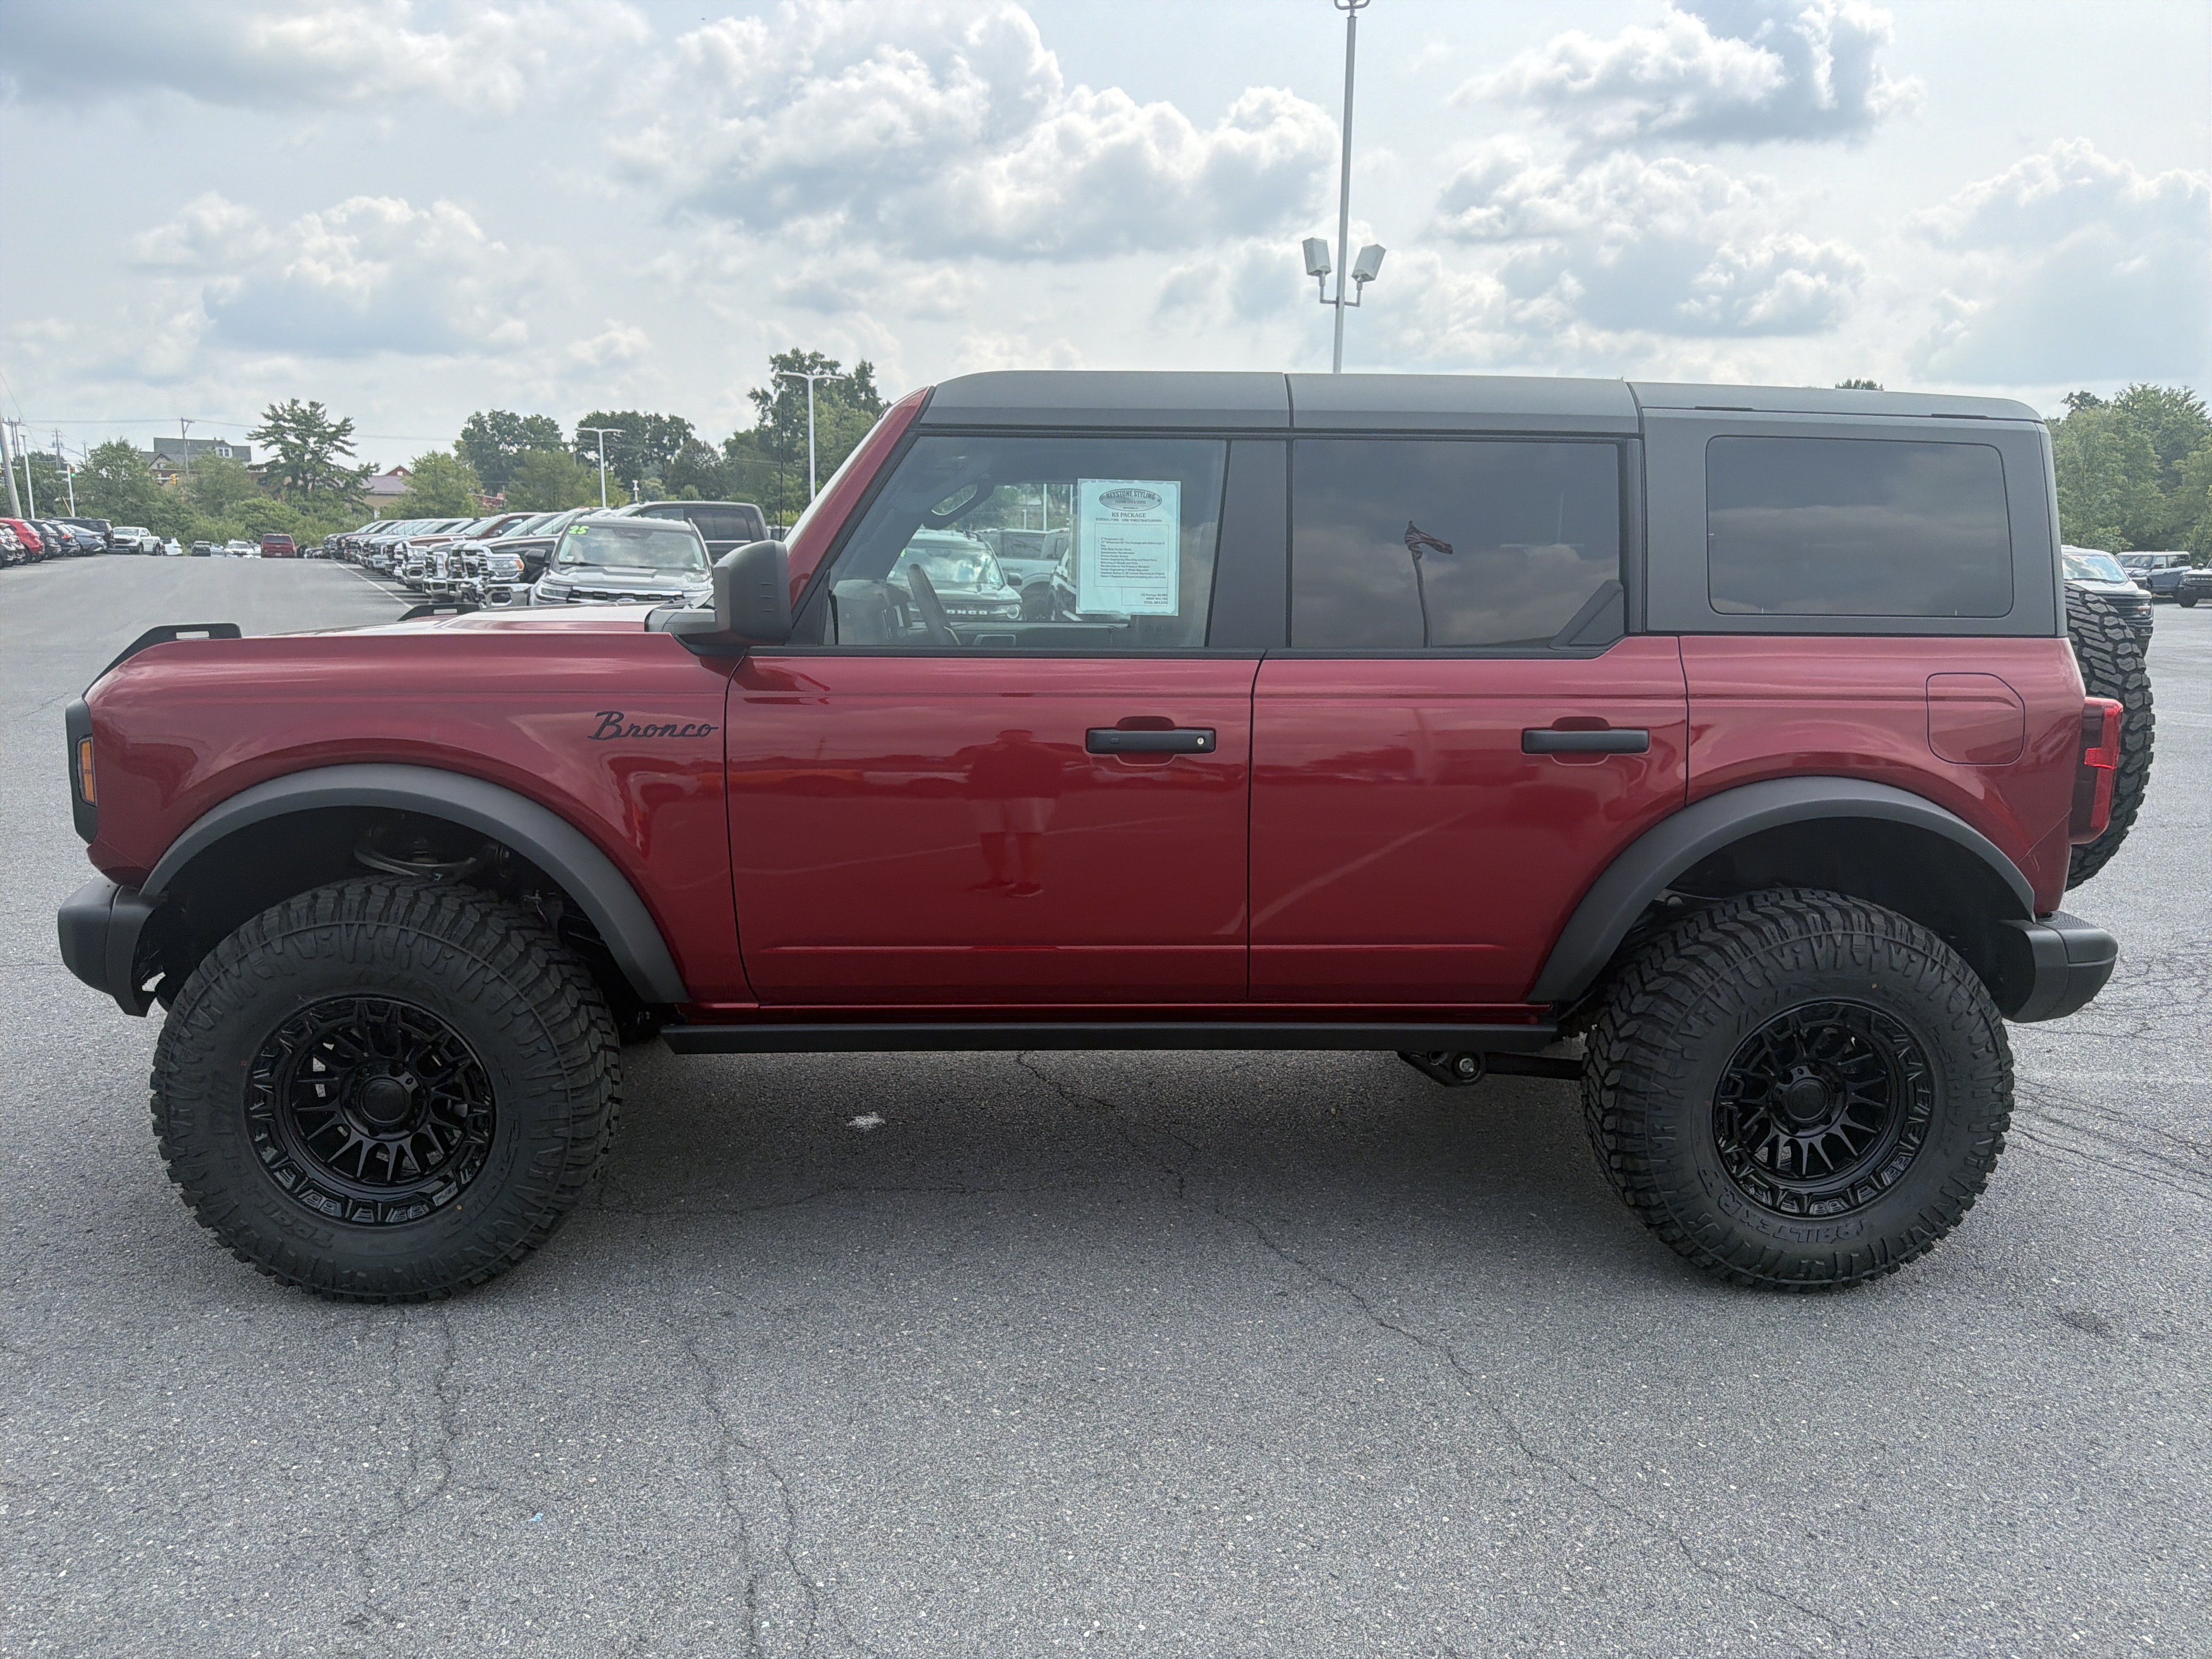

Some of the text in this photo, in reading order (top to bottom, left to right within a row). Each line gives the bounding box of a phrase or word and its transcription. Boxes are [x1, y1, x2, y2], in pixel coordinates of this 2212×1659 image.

[1105, 490, 1155, 500] KEYSTONE STYLING
[568, 525, 589, 534] 25
[588, 711, 719, 741] Bronco
